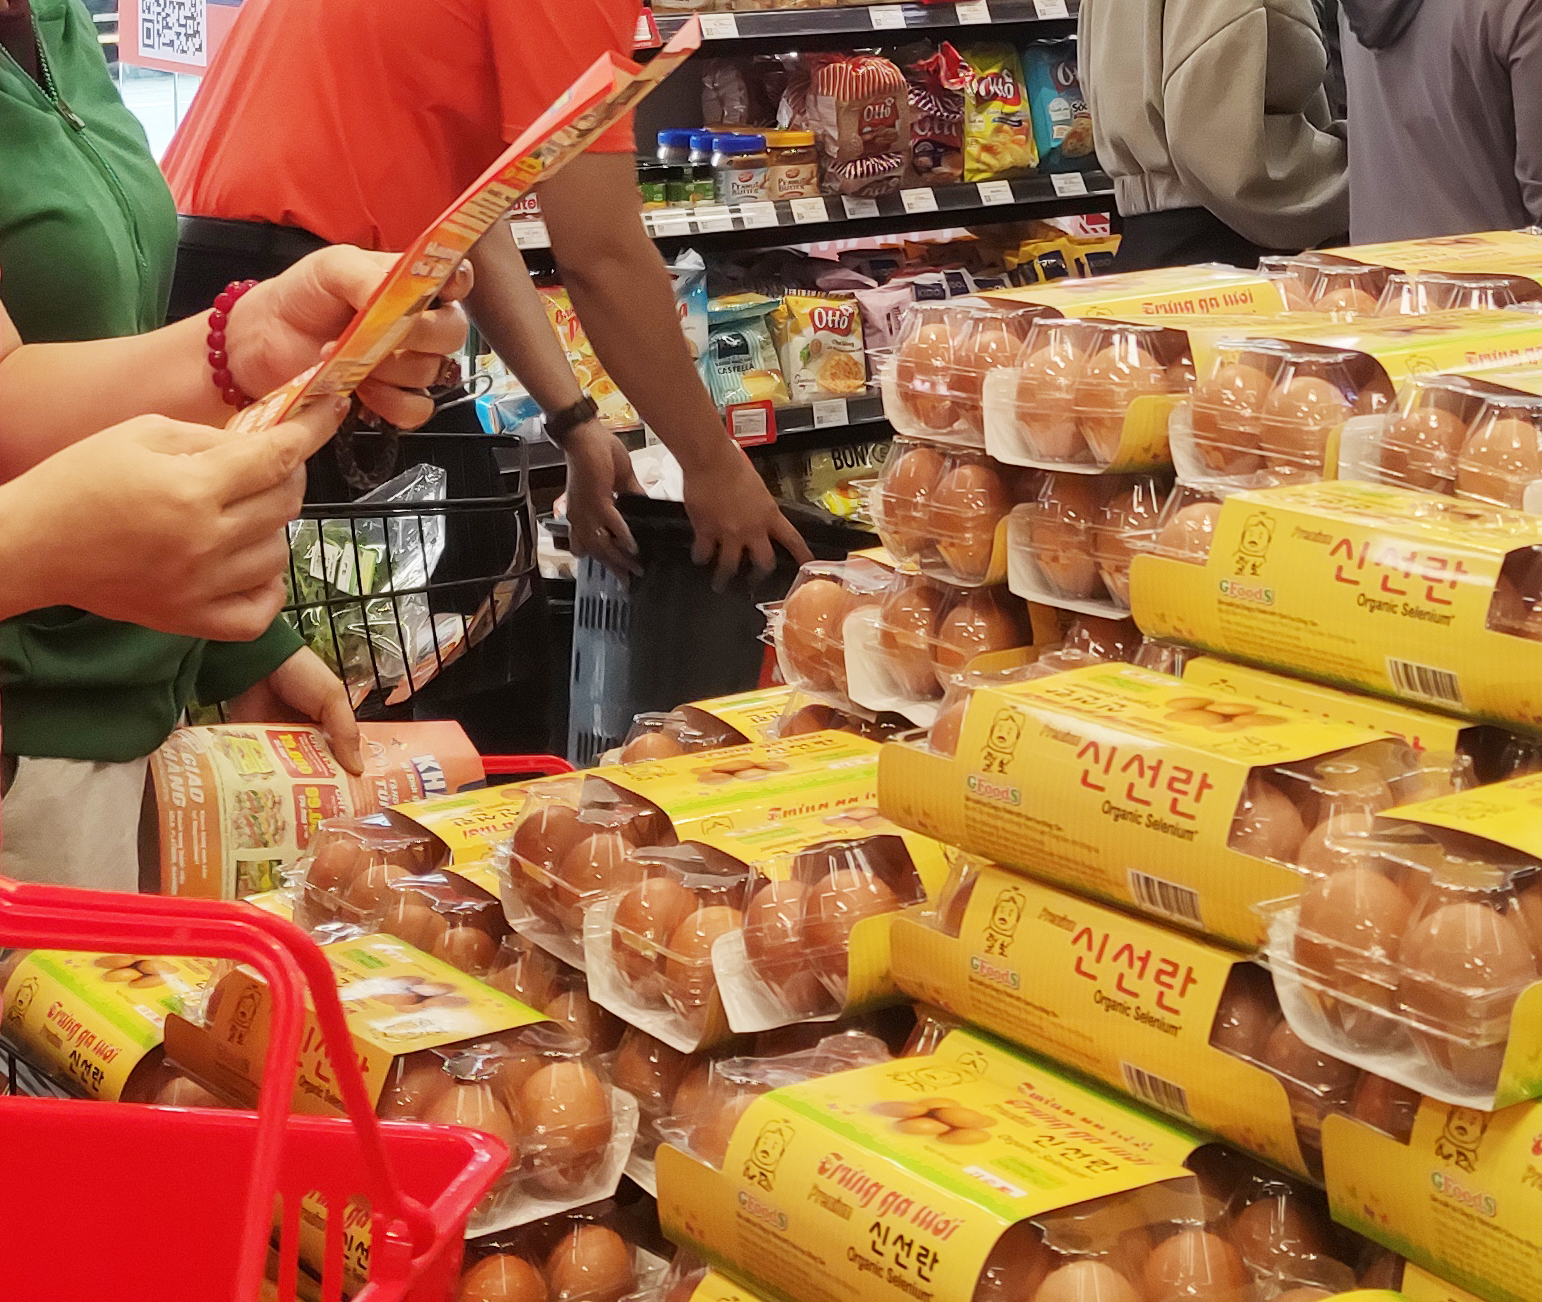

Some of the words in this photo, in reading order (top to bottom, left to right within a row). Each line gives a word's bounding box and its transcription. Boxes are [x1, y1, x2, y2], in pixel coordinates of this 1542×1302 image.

[1328, 537, 1469, 606] 신선란
[1357, 593, 1399, 614] Organic
[1076, 740, 1214, 821] 신선란
[1101, 800, 1143, 826] Organic
[1070, 926, 1198, 1017] 신선란
[1093, 990, 1133, 1019] Organic
[868, 1221, 939, 1283] 신선란
